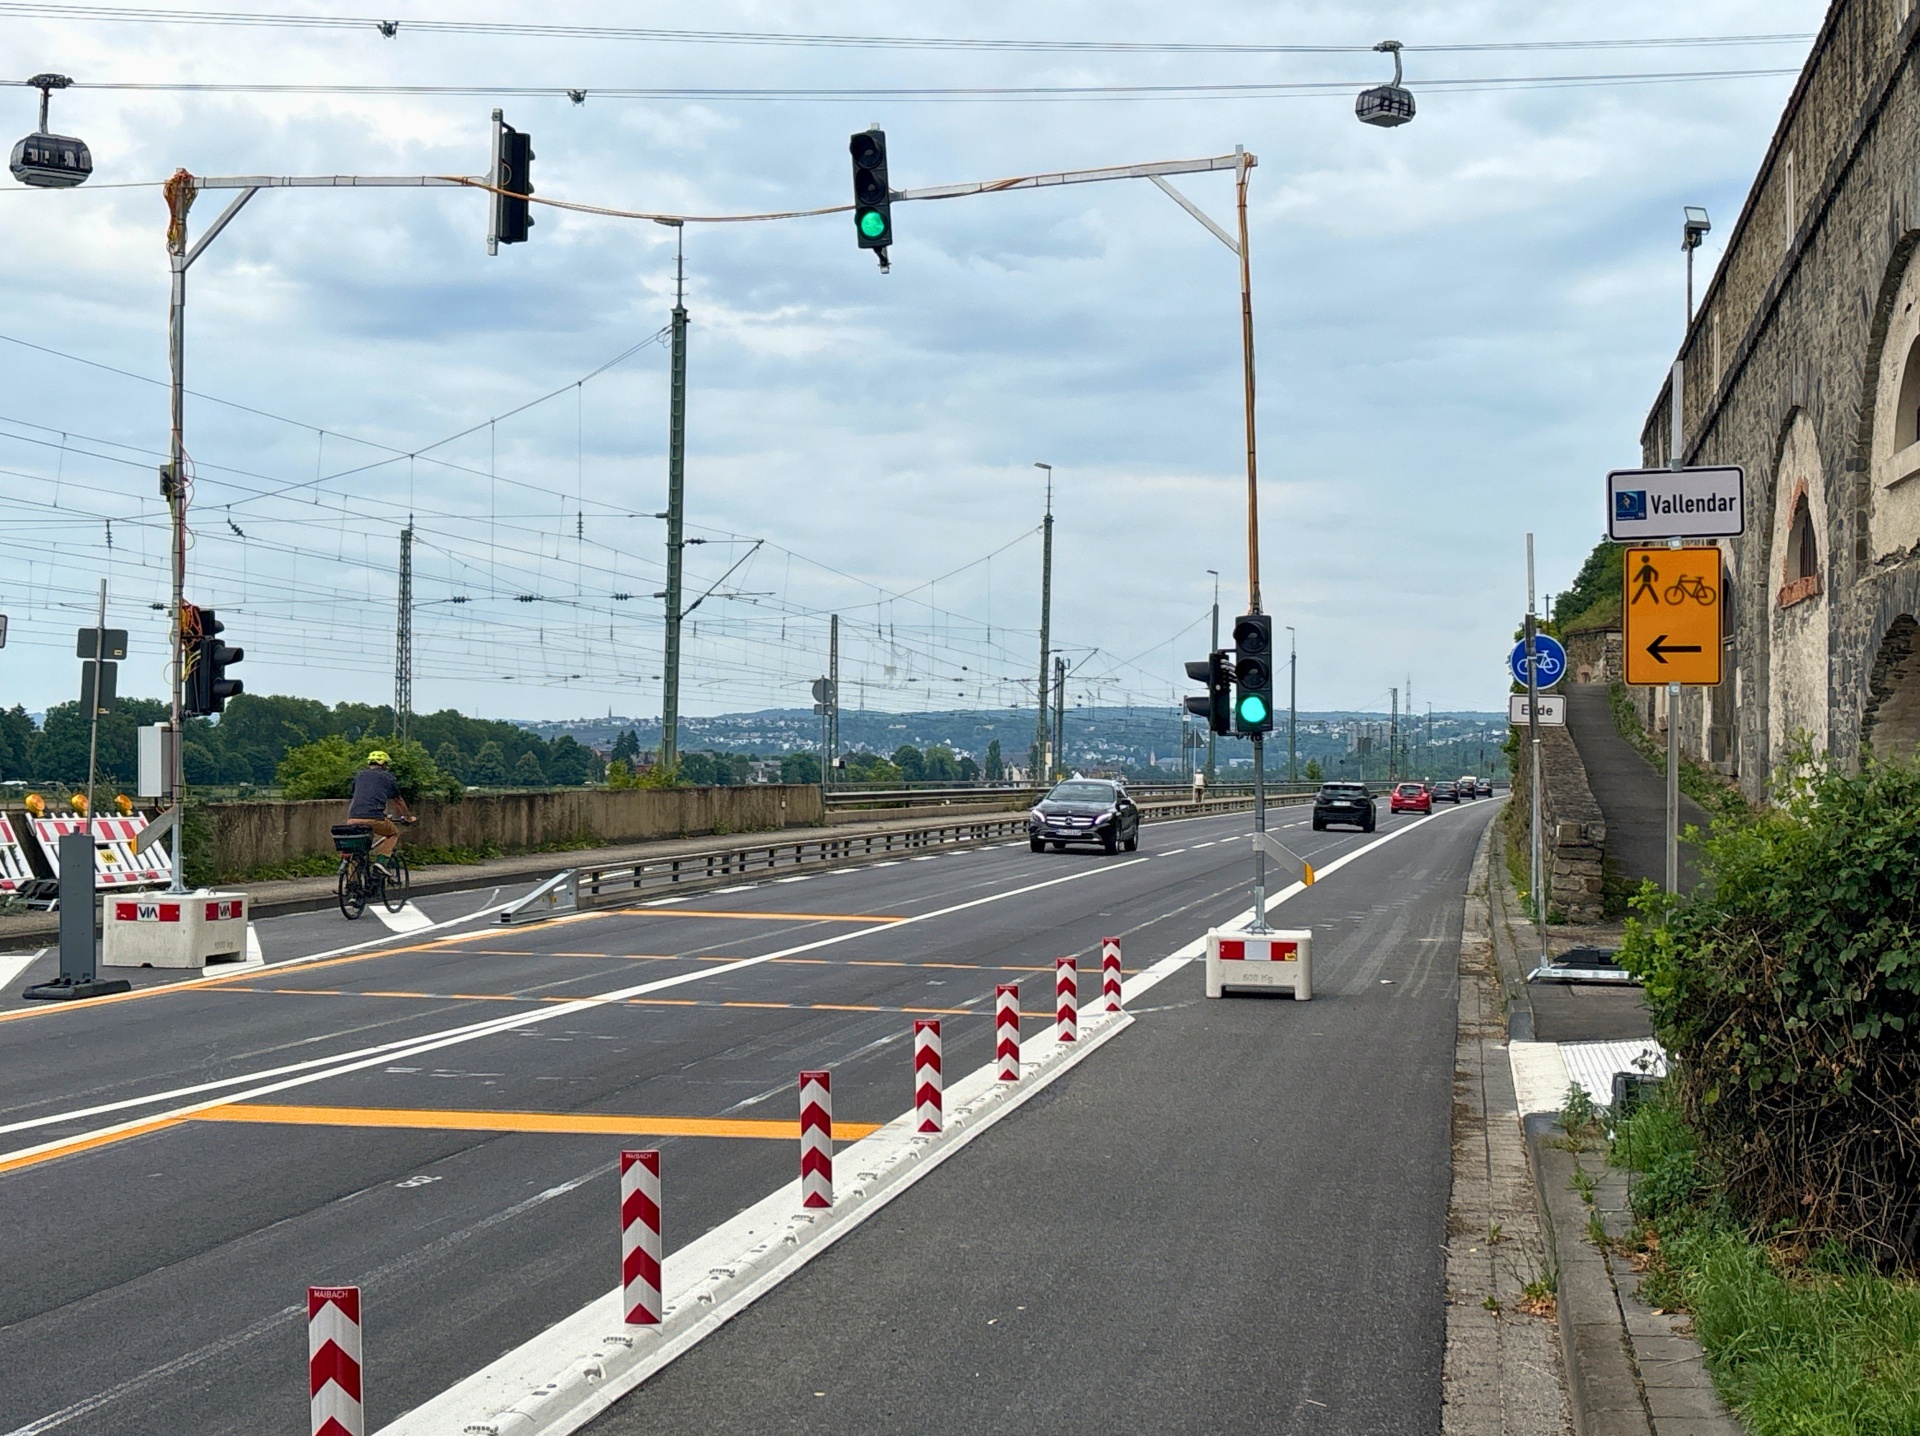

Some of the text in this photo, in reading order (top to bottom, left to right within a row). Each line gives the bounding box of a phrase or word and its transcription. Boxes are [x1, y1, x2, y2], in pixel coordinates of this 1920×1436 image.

[1650, 492, 1737, 514] Vallendar
[1520, 704, 1554, 715] Ede
[138, 906, 158, 919] VIA
[313, 1290, 348, 1299] MAIBACH
